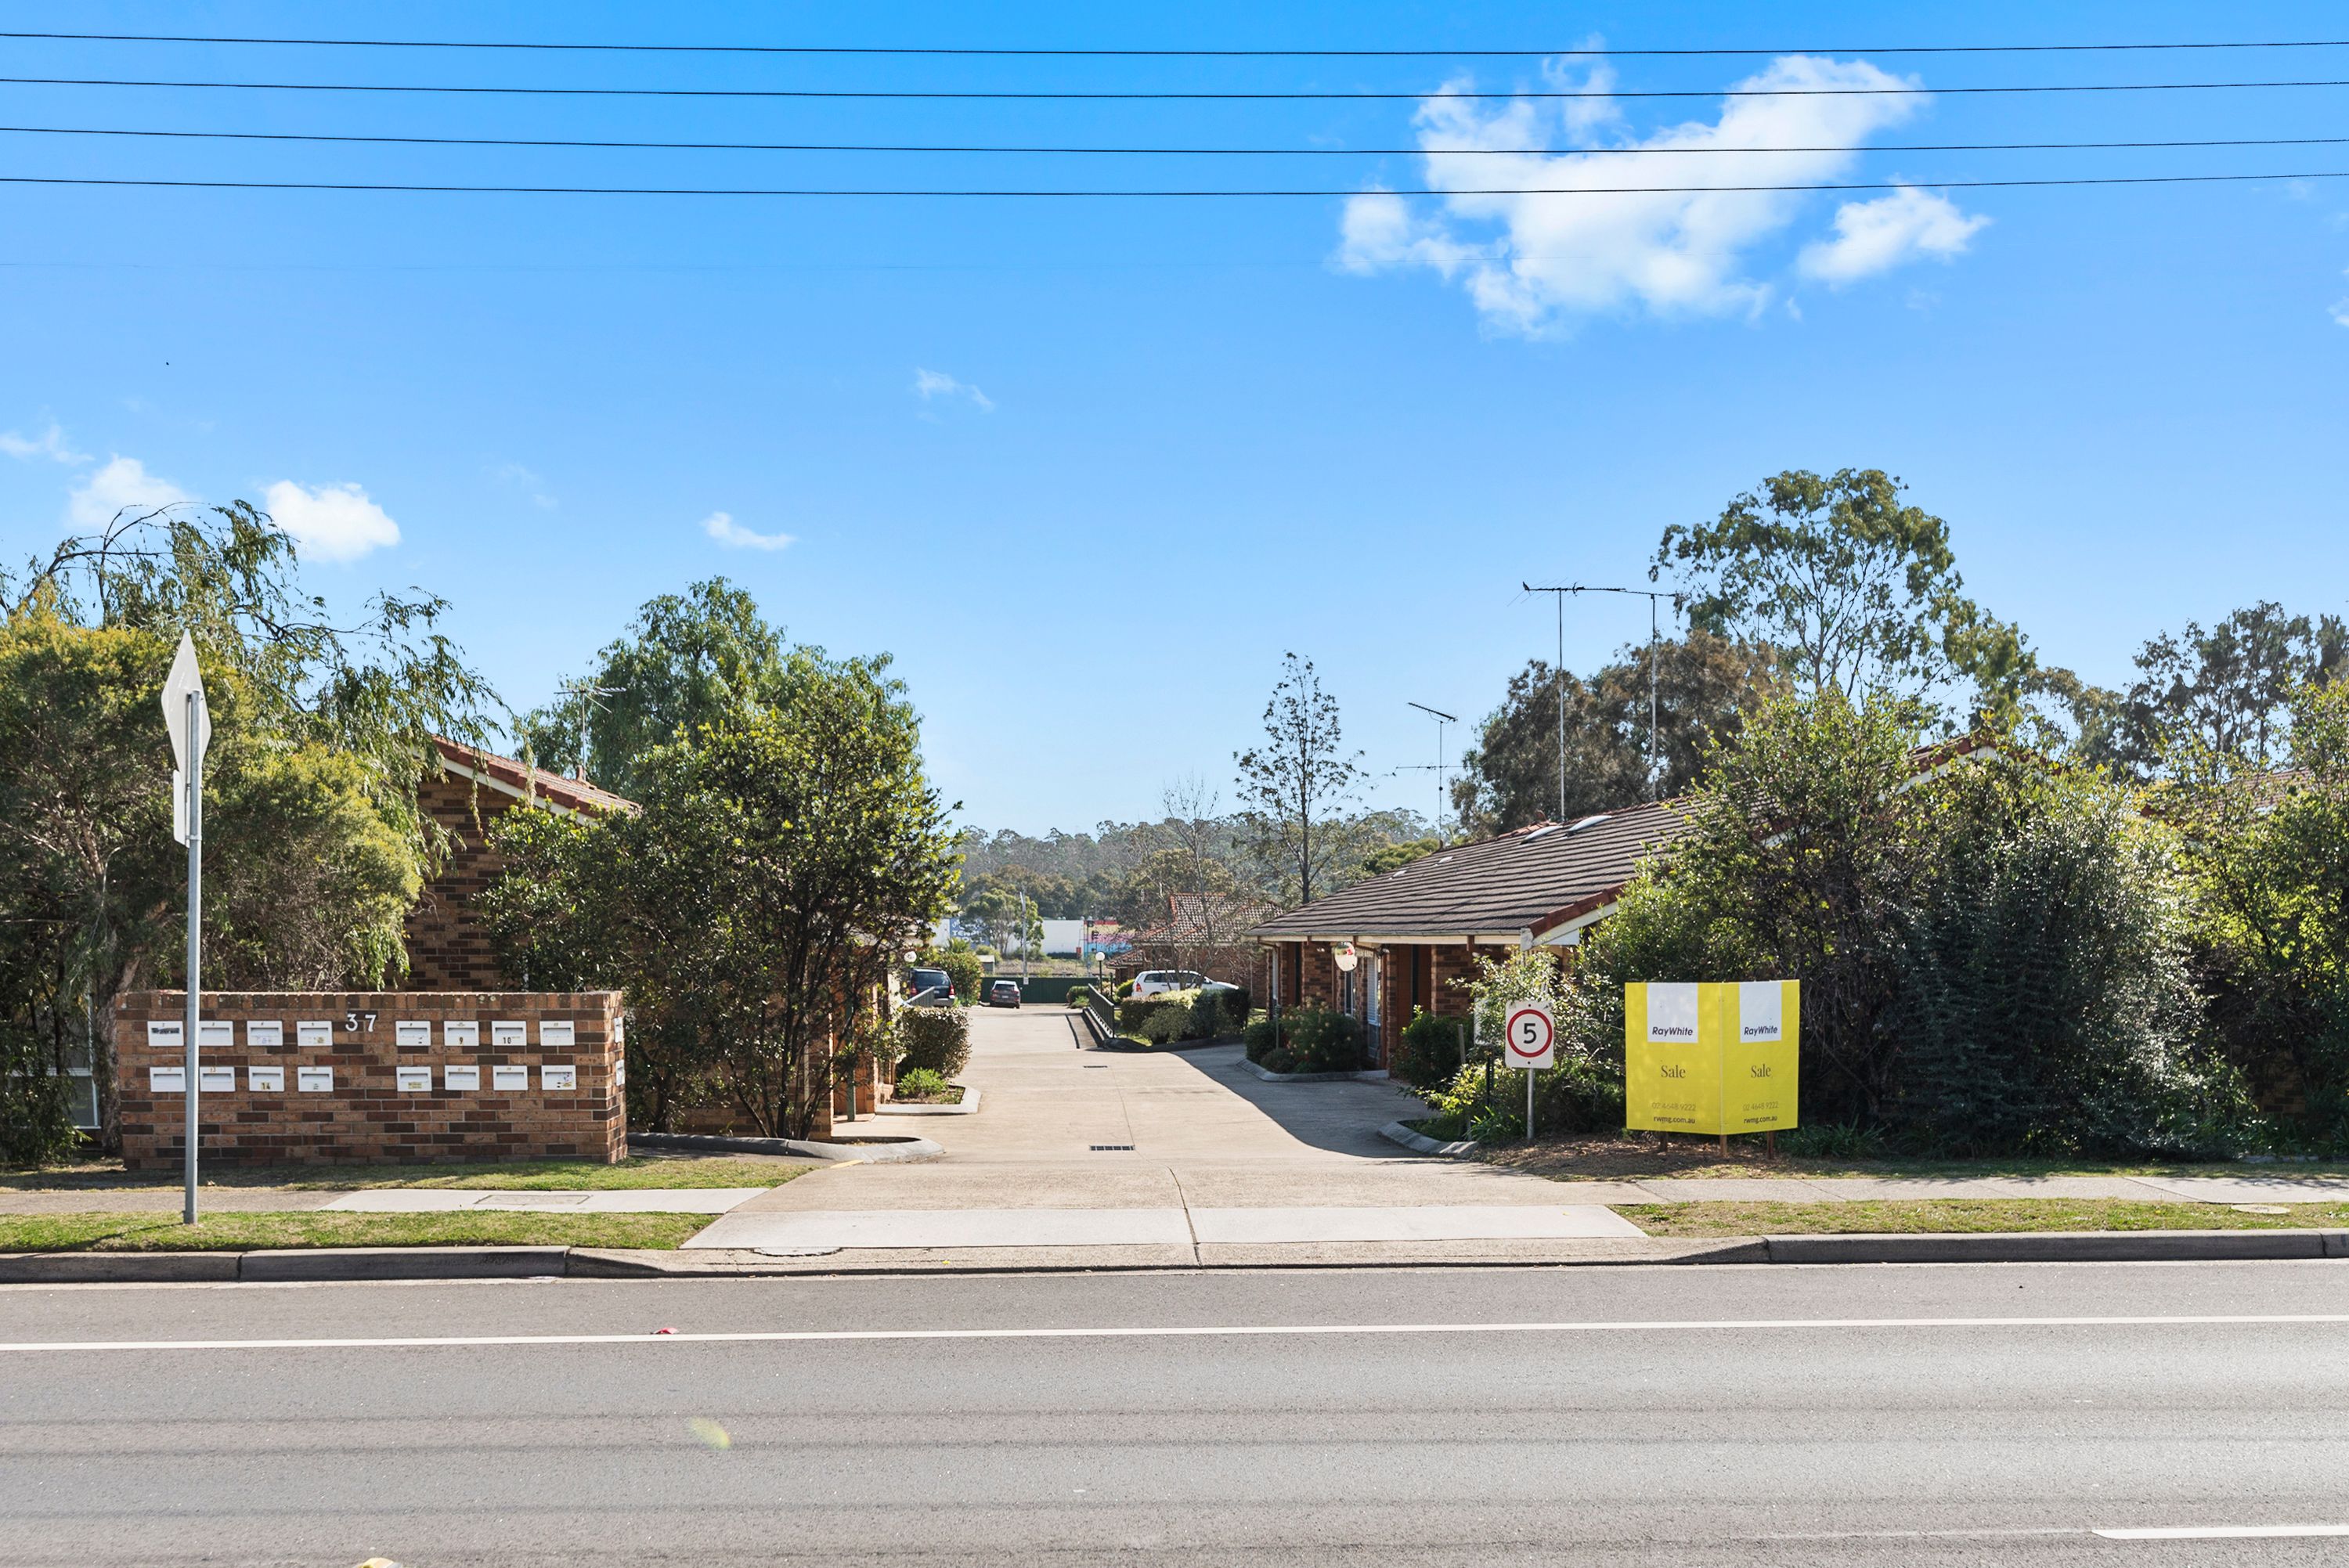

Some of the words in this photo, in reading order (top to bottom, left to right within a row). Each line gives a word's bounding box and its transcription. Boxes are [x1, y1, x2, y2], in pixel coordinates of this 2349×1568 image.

[345, 1013, 377, 1033] 37
[1523, 1022, 1537, 1044] 5
[1652, 1026, 1694, 1037] RayWhite
[1744, 1025, 1778, 1036] RayWhite
[1660, 1064, 1686, 1078] Sale
[1751, 1063, 1771, 1078] Sale
[1653, 1116, 1696, 1124] rwmg.com.au
[1744, 1116, 1777, 1124] rwmg.com.au
